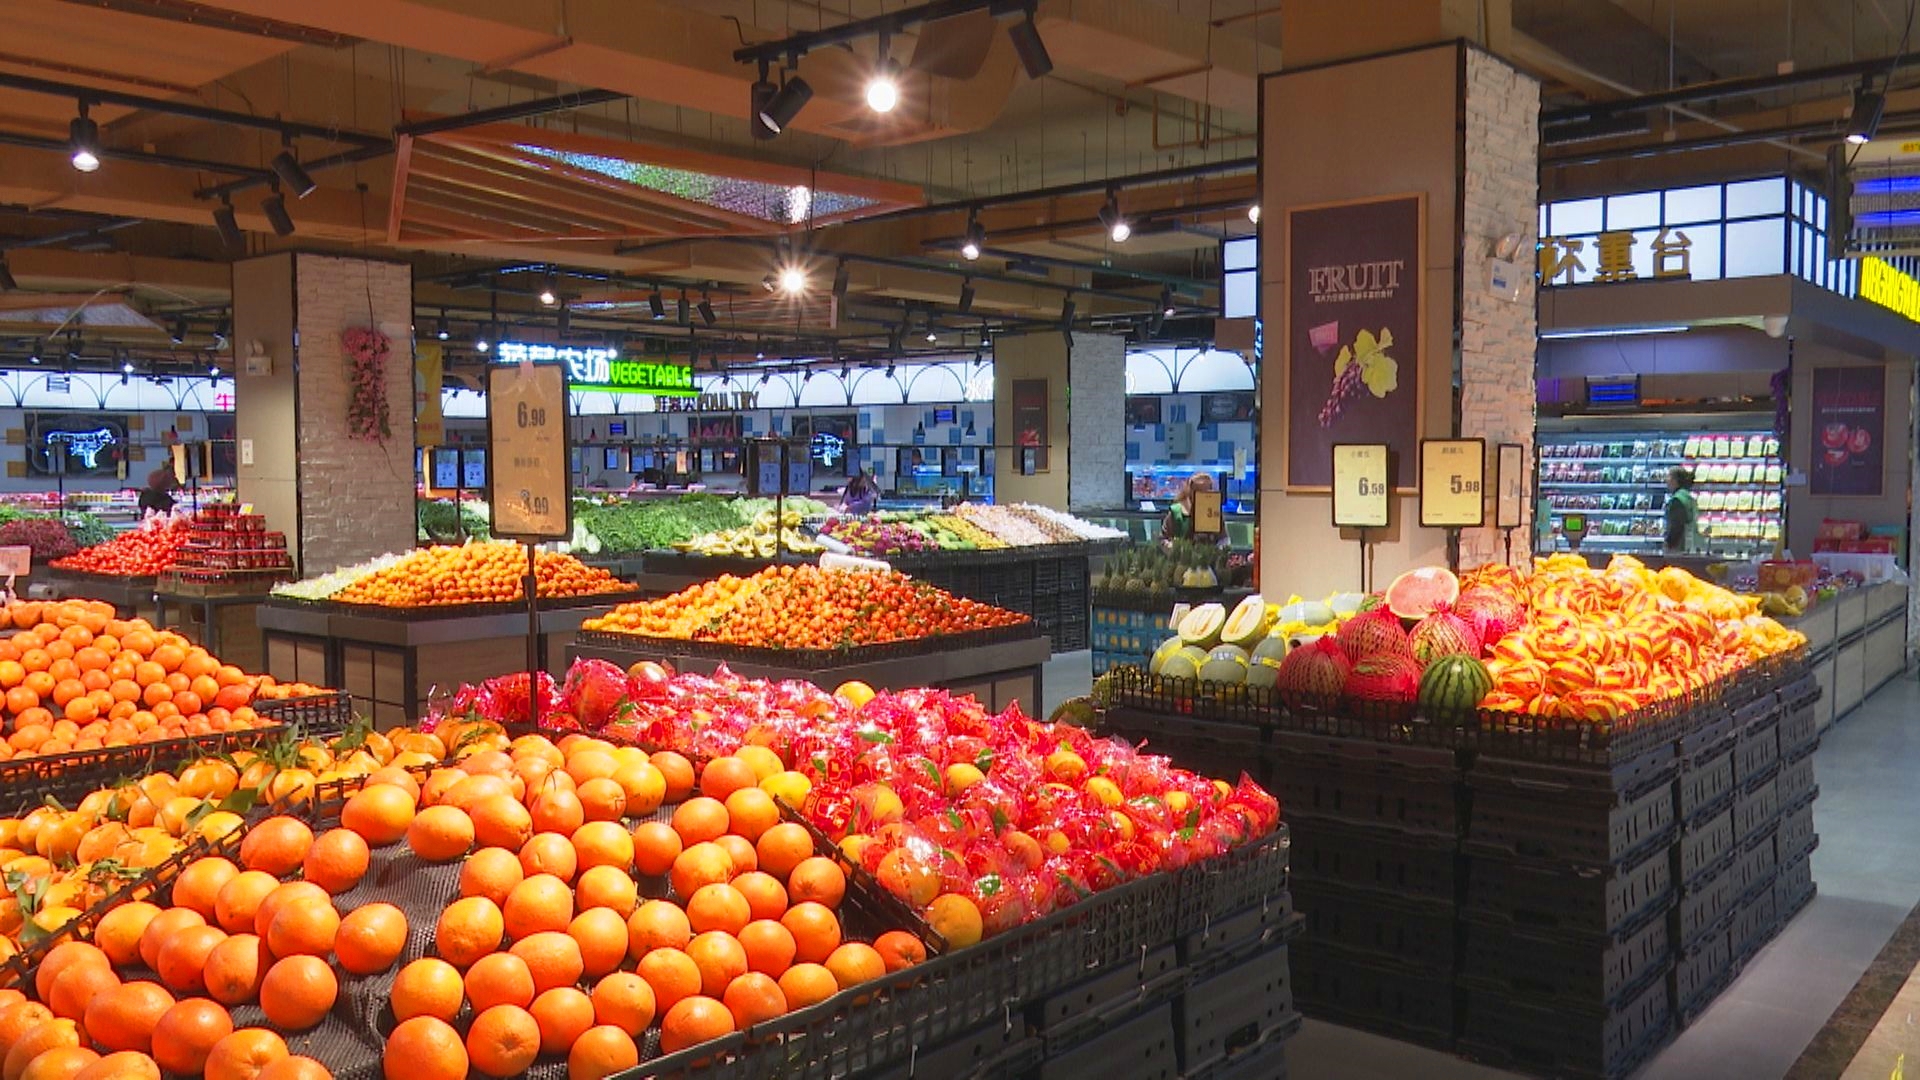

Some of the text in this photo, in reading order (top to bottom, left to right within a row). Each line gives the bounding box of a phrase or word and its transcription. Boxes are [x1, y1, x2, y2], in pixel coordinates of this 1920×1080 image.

[1538, 227, 1692, 287] 称重台
[1308, 260, 1404, 296] FRUIT
[610, 360, 692, 388] VEGETABLE
[517, 401, 546, 428] 6.98
[698, 391, 760, 412] POULTRY
[1358, 477, 1385, 496] 6.58
[1450, 474, 1480, 494] 5.98
